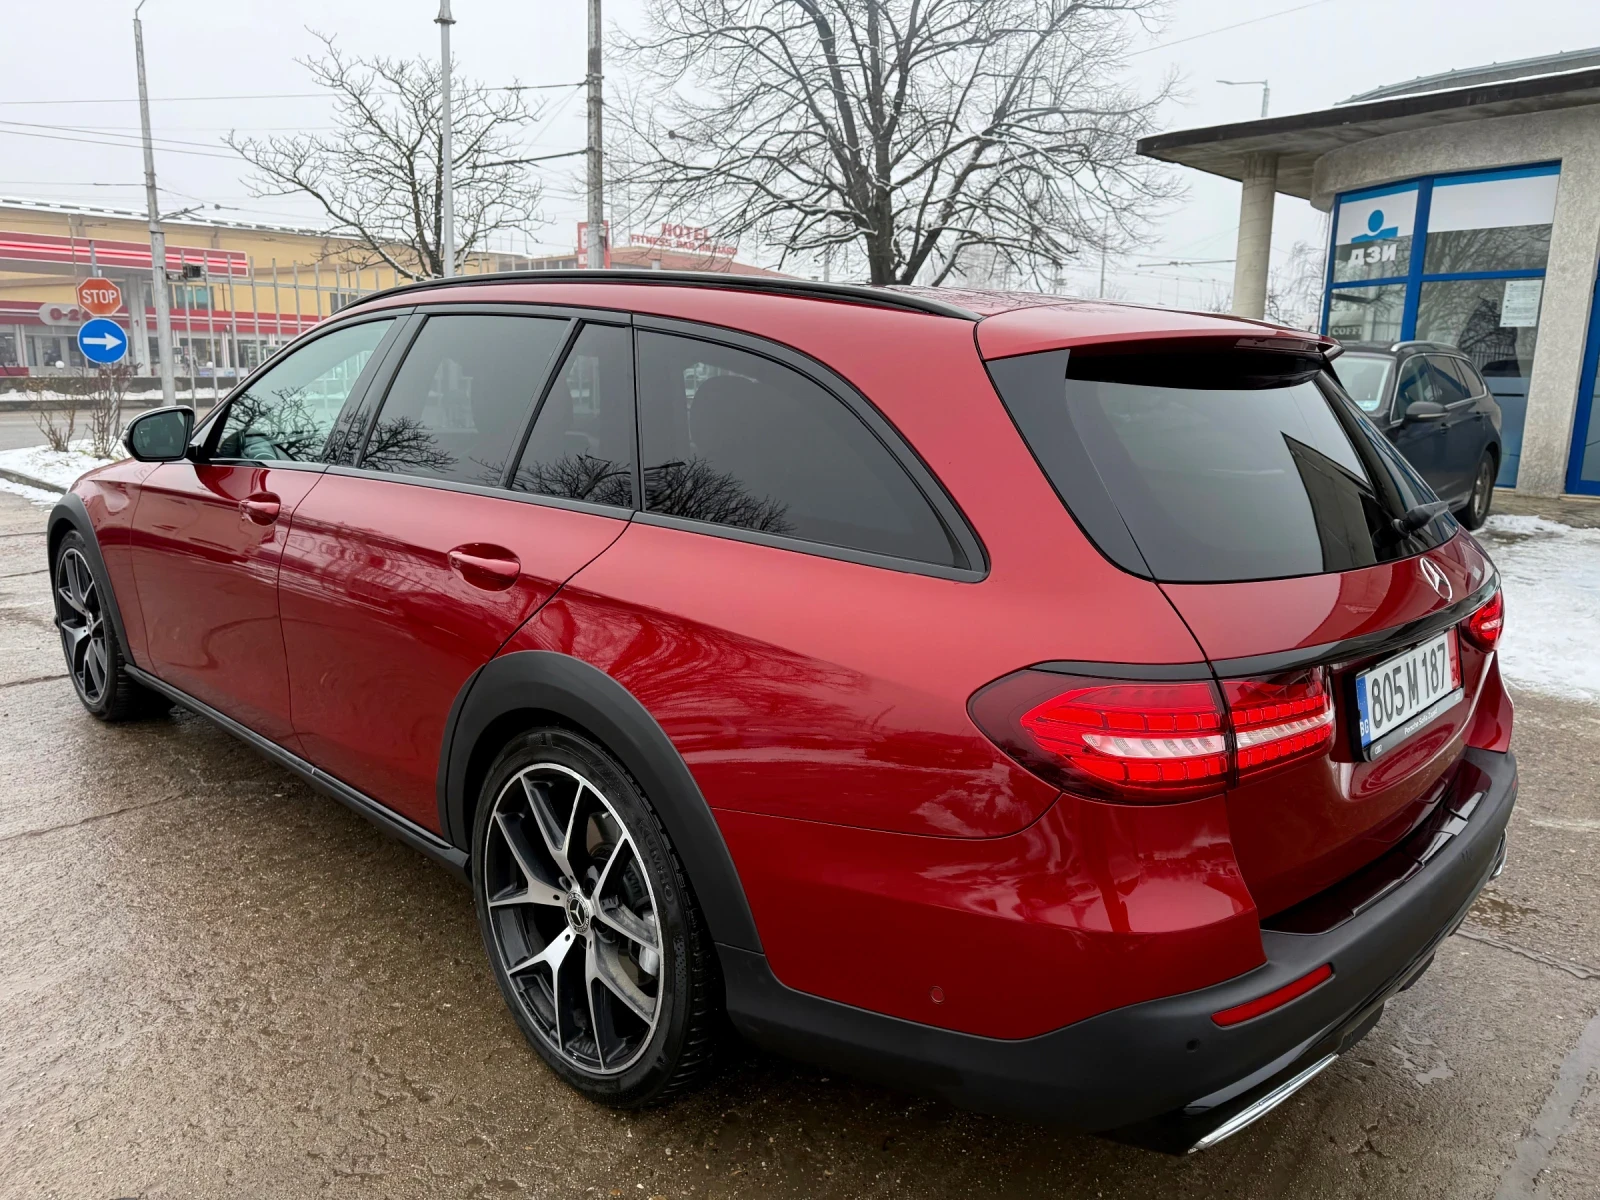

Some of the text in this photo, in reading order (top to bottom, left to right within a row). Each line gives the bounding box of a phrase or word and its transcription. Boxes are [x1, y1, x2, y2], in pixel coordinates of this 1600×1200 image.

[661, 222, 710, 240] HOTEL
[1349, 243, 1397, 266] ДЗИ
[82, 289, 117, 304] STOP
[1360, 719, 1370, 736] BG
[1371, 665, 1405, 729] 805
[1406, 657, 1419, 710] M
[1422, 642, 1446, 700] 187
[636, 817, 676, 903] KUMHO
